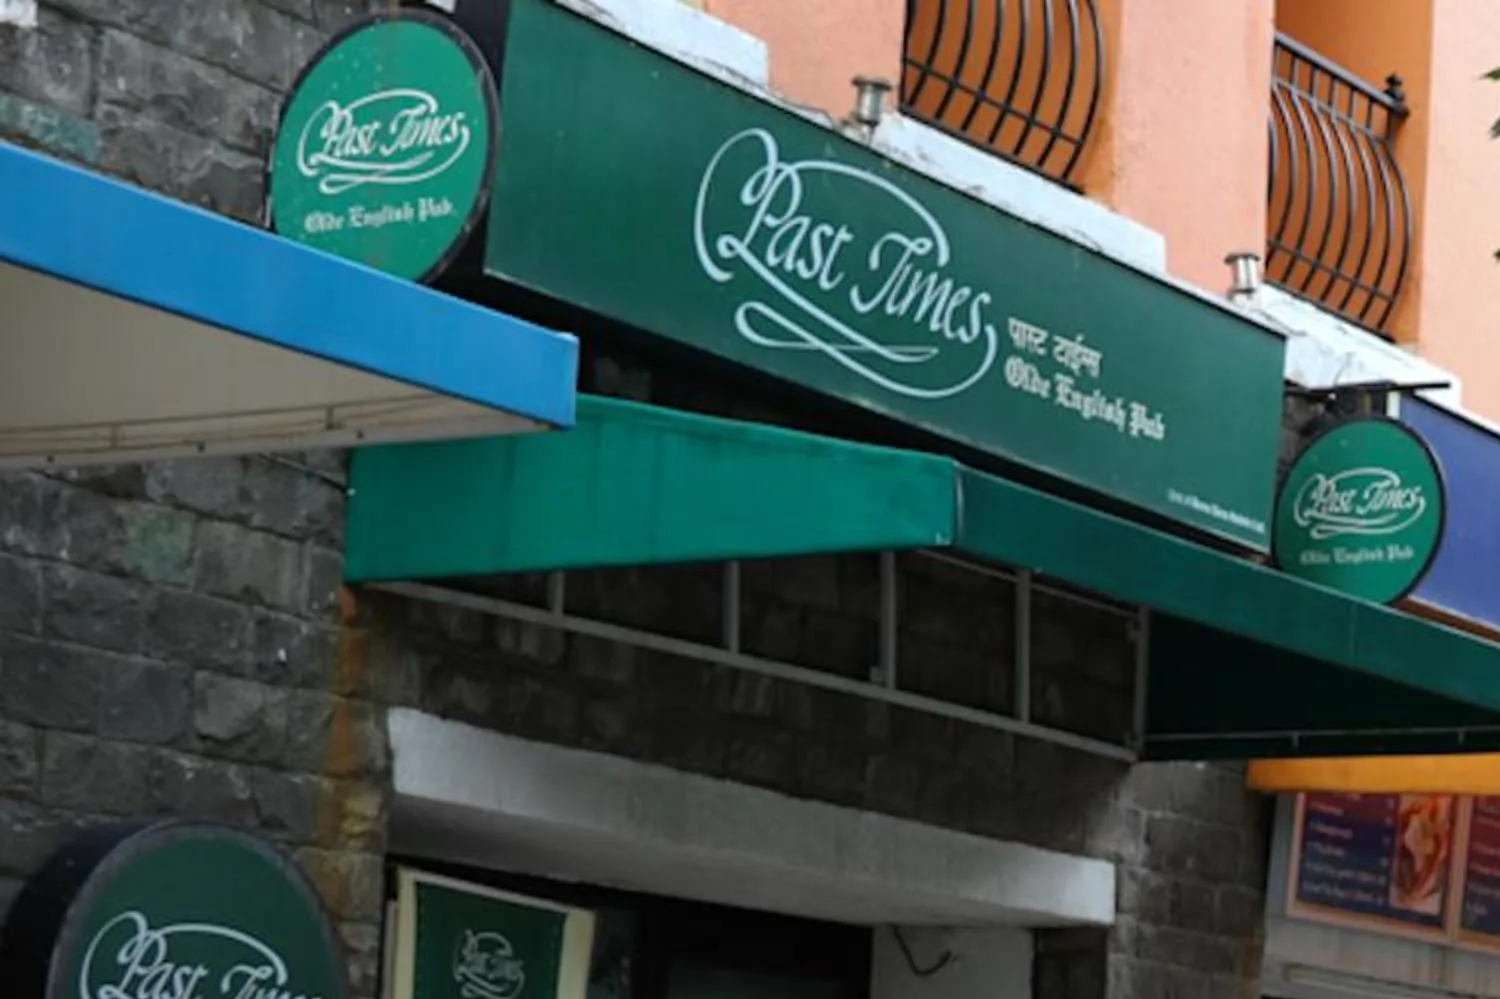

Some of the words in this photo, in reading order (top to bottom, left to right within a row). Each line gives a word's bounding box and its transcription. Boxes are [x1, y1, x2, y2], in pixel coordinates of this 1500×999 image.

[348, 204, 414, 227] English
[418, 197, 453, 222] Pub
[850, 231, 990, 343] Times
[1054, 372, 1126, 432] English
[1128, 402, 1165, 440] Pub
